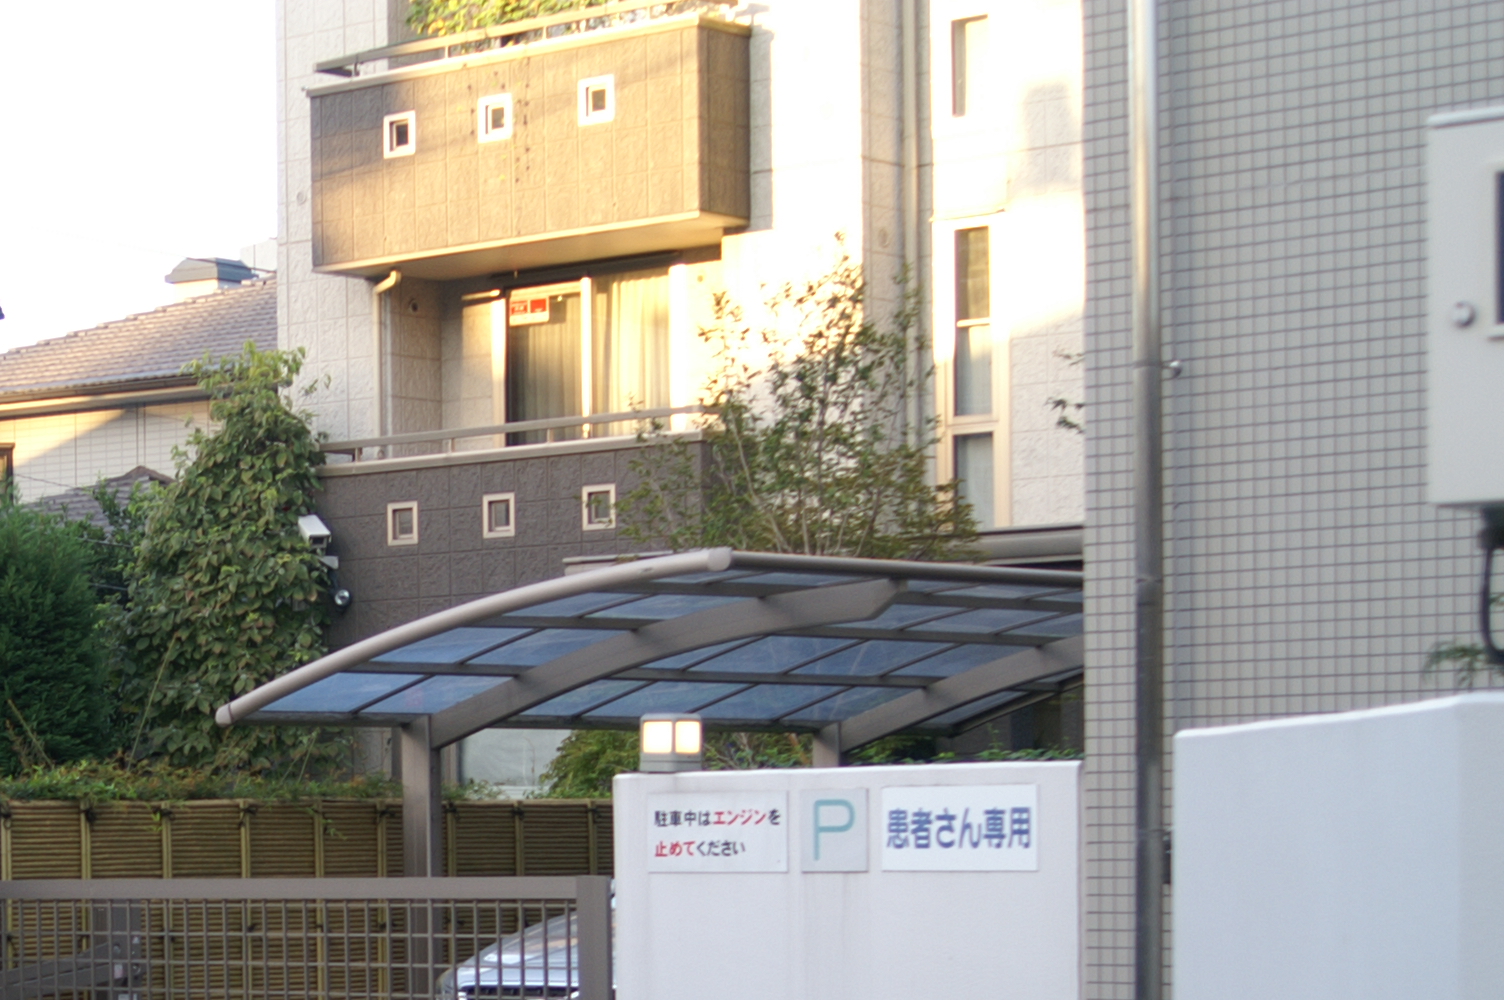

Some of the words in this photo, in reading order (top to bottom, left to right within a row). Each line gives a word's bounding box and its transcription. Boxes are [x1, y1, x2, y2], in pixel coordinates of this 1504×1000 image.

[654, 808, 781, 827] 駐車中はエンジンを
[814, 799, 855, 861] P
[887, 807, 1031, 849] 患者さん専用
[654, 840, 746, 858] 止めてください
